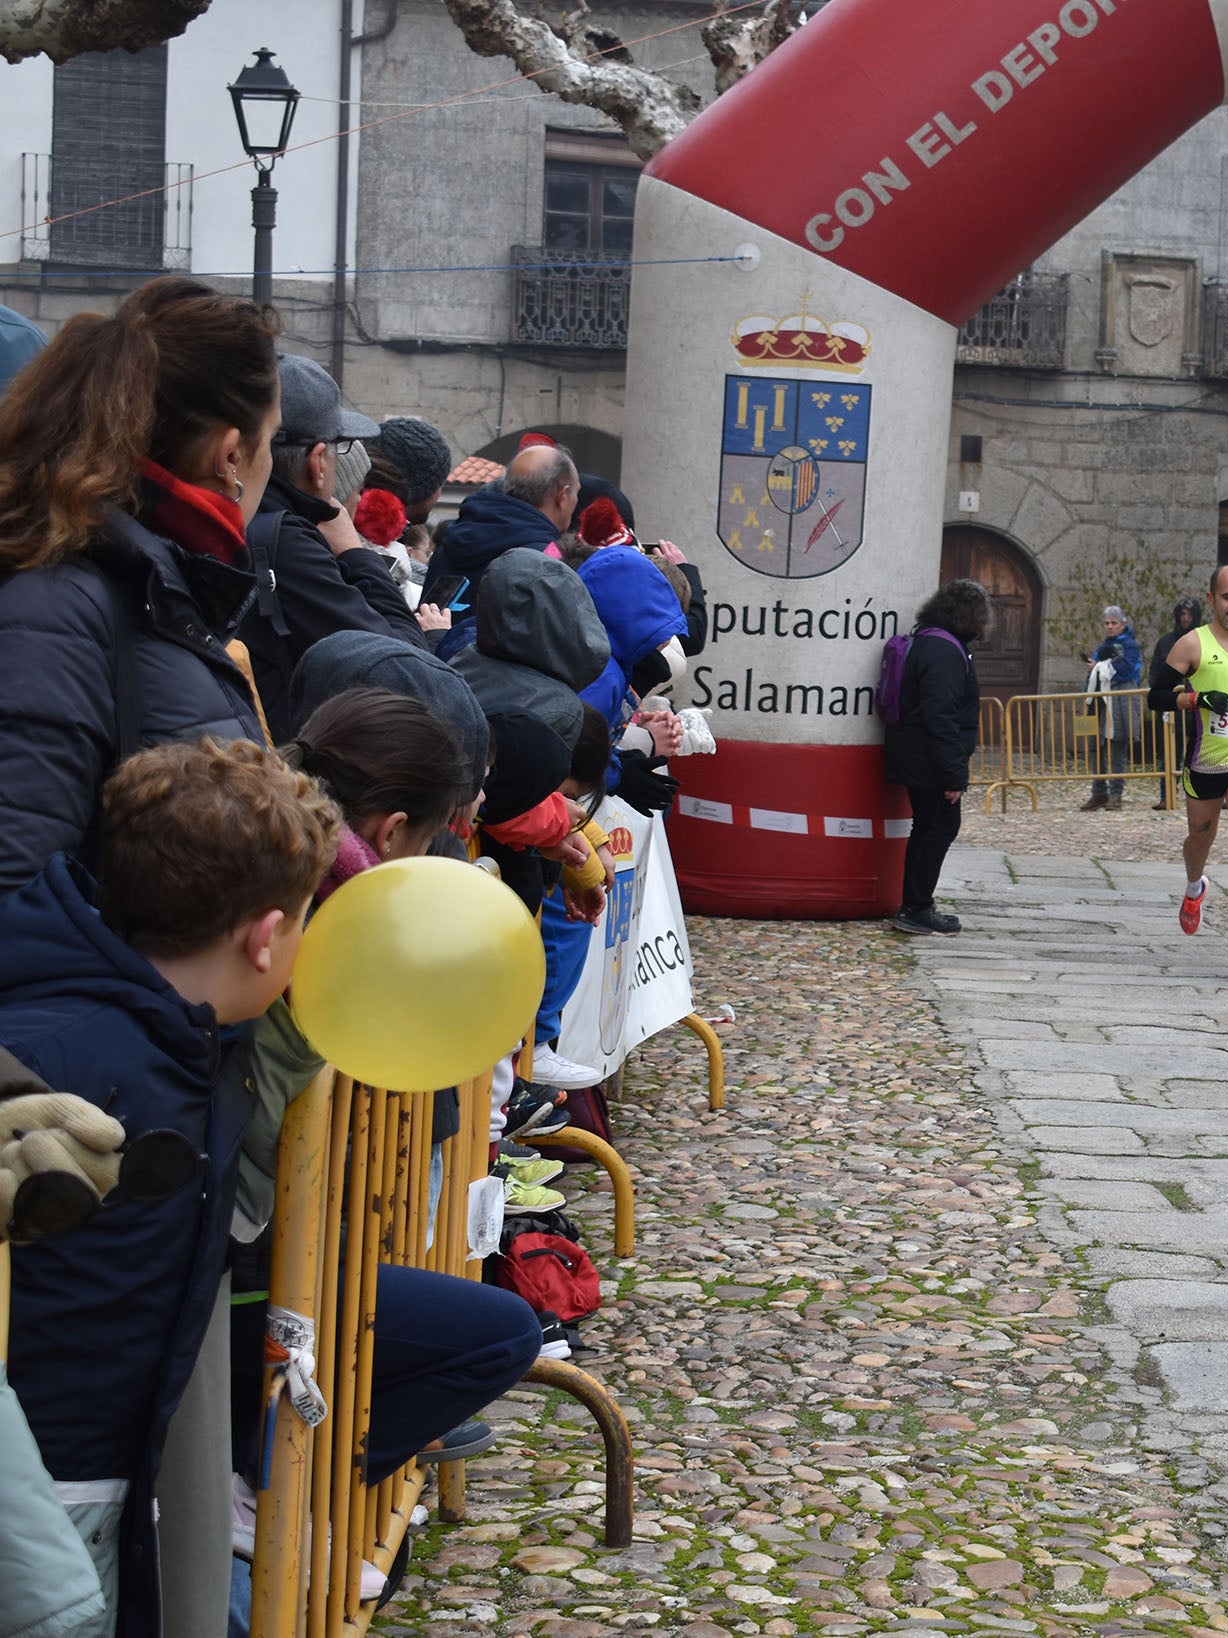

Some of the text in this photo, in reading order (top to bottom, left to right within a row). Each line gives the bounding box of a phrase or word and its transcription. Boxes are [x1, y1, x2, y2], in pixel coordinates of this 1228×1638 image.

[804, 0, 1117, 251] CON EL DEPO
[691, 665, 874, 716] Salaman
